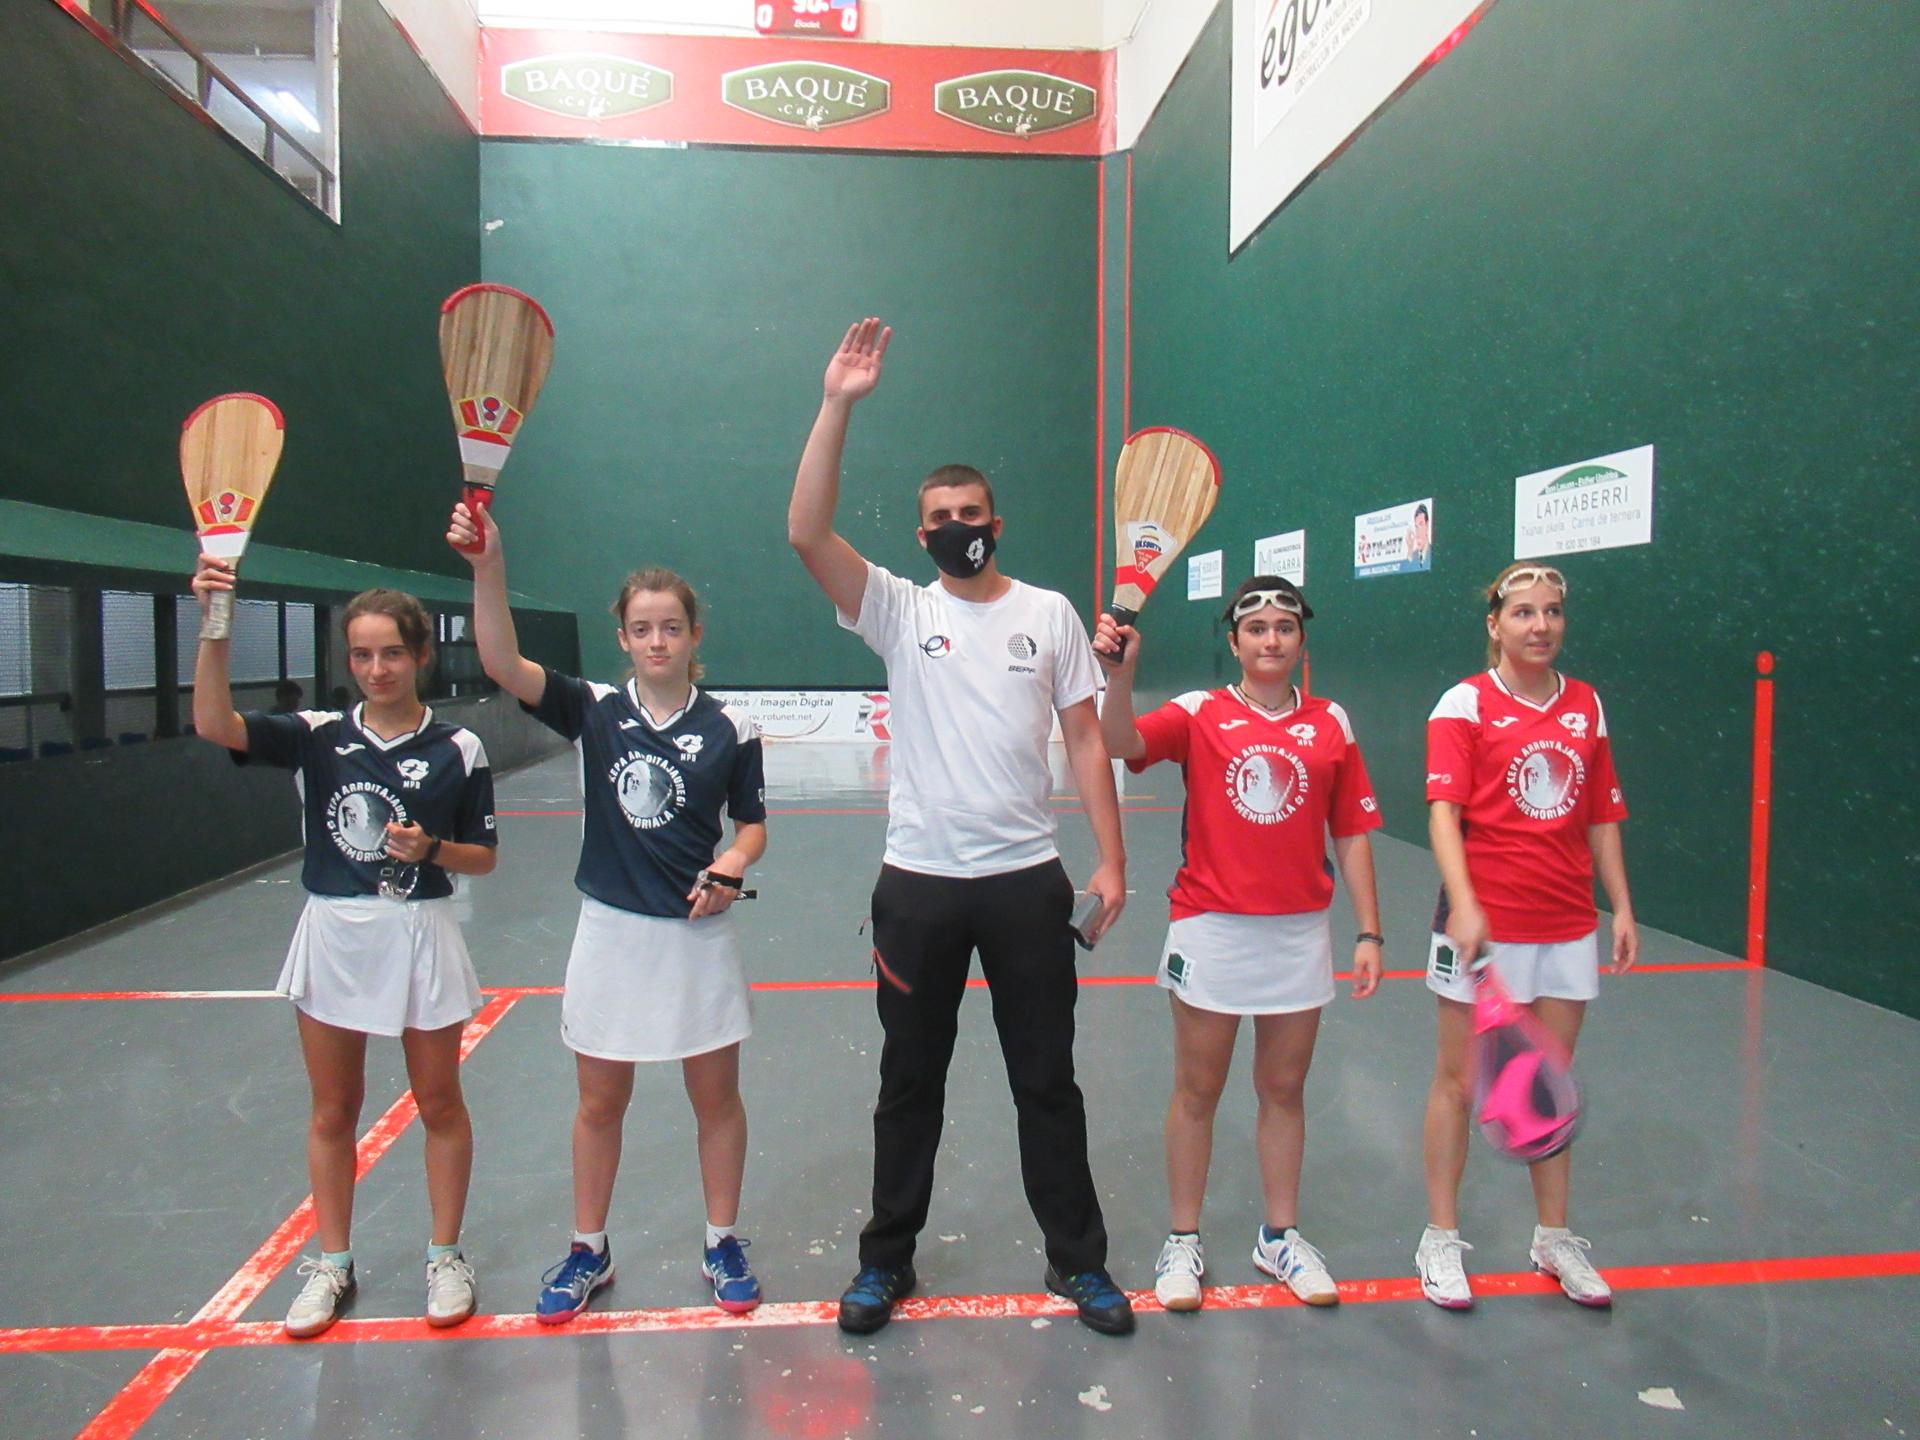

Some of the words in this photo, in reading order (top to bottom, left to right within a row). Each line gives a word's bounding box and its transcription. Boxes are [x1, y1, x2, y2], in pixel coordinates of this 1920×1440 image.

[525, 67, 650, 98] BAQUÉ
[745, 76, 868, 108] BAQUÉ
[957, 85, 1075, 115] BAQUÉ
[1536, 485, 1629, 519] LATXABERRI
[749, 712, 812, 721] w.rotunet.net
[760, 698, 797, 709] Imagen
[799, 697, 834, 709] Digital
[1225, 756, 1242, 783] KEPA
[1506, 756, 1523, 784] KEPA
